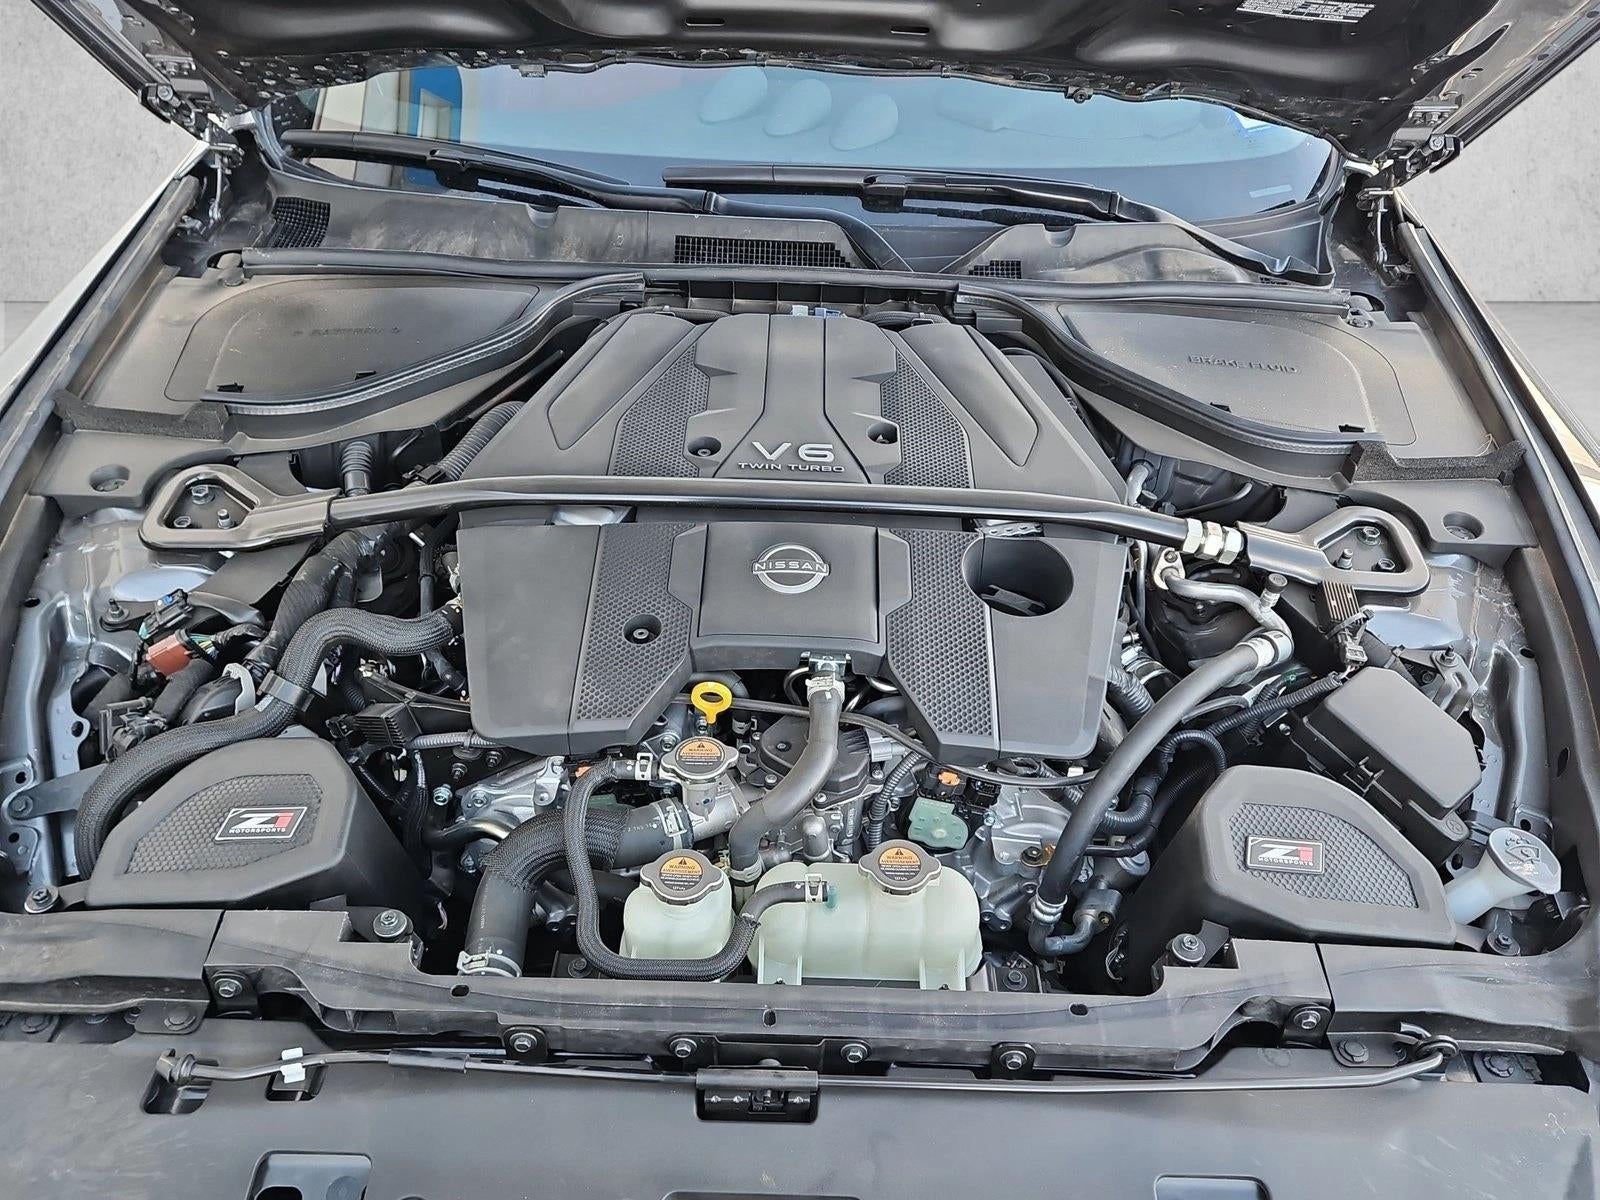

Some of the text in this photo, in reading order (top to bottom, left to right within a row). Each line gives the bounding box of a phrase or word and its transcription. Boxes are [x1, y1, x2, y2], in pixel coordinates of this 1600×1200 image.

[1188, 355, 1298, 373] BRAKE FLUID
[752, 441, 835, 463] V6
[738, 462, 845, 473] TWIN TURBO
[754, 560, 829, 573] NISSAN
[1257, 856, 1314, 866] MOTORSPORTS
